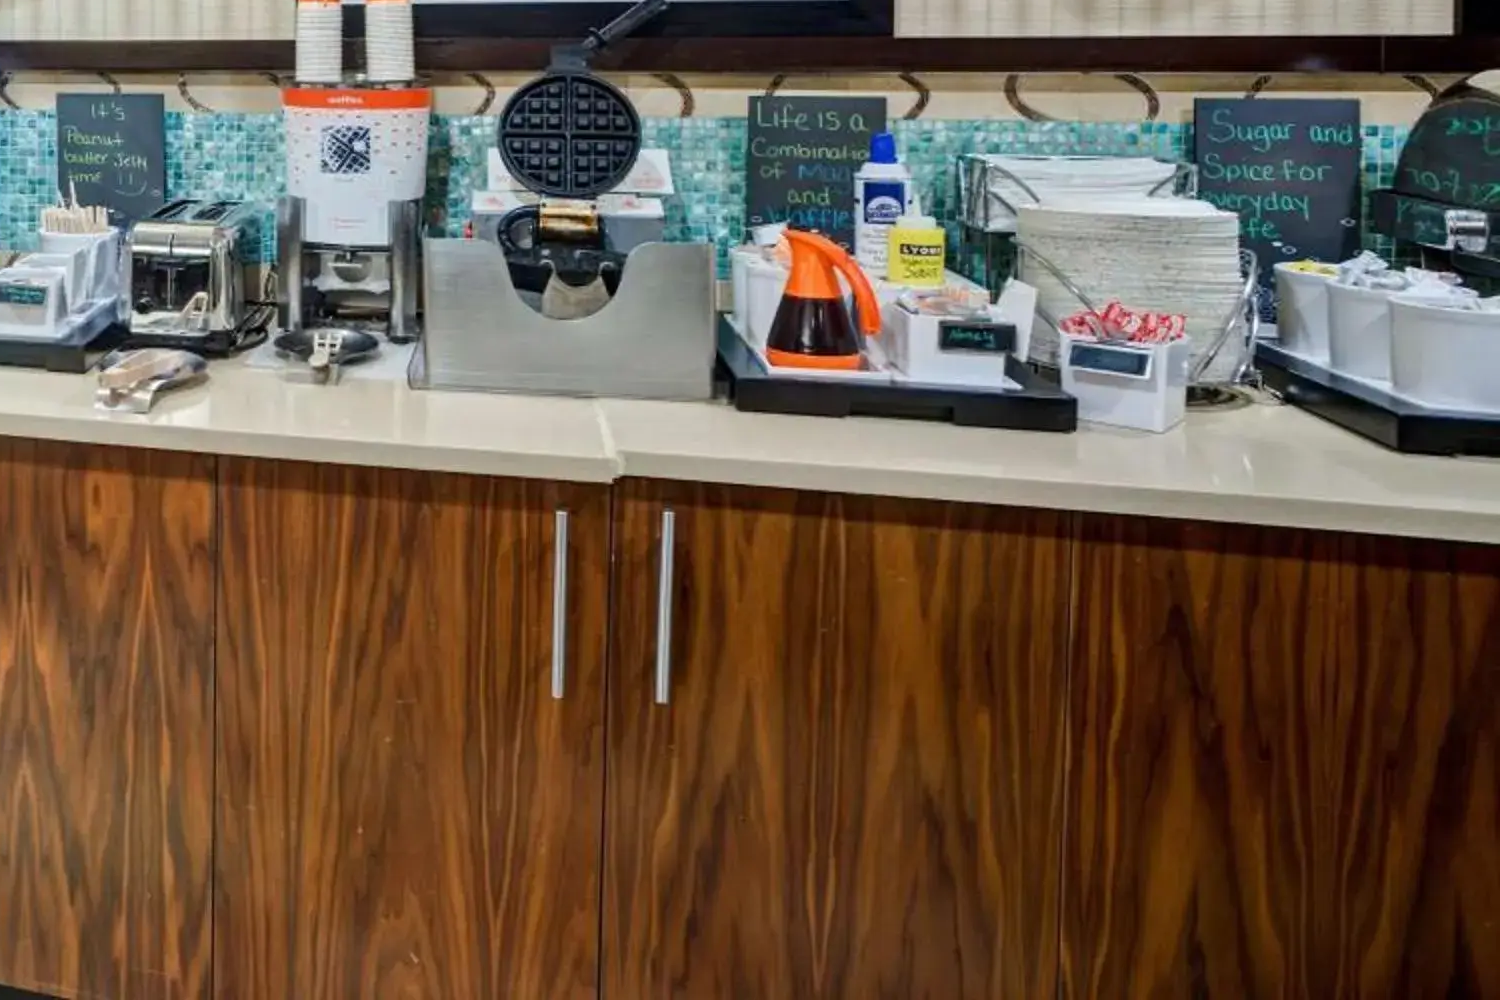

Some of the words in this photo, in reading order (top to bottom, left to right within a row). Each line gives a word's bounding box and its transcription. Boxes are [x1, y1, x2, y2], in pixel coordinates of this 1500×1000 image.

[756, 101, 812, 131] Life
[849, 112, 869, 132] a
[1207, 108, 1296, 152] Sugar
[1310, 123, 1353, 145] and
[62, 125, 125, 146] Peanut
[751, 136, 870, 160] Combinatio
[1202, 153, 1276, 183] Spice
[788, 187, 831, 205] and
